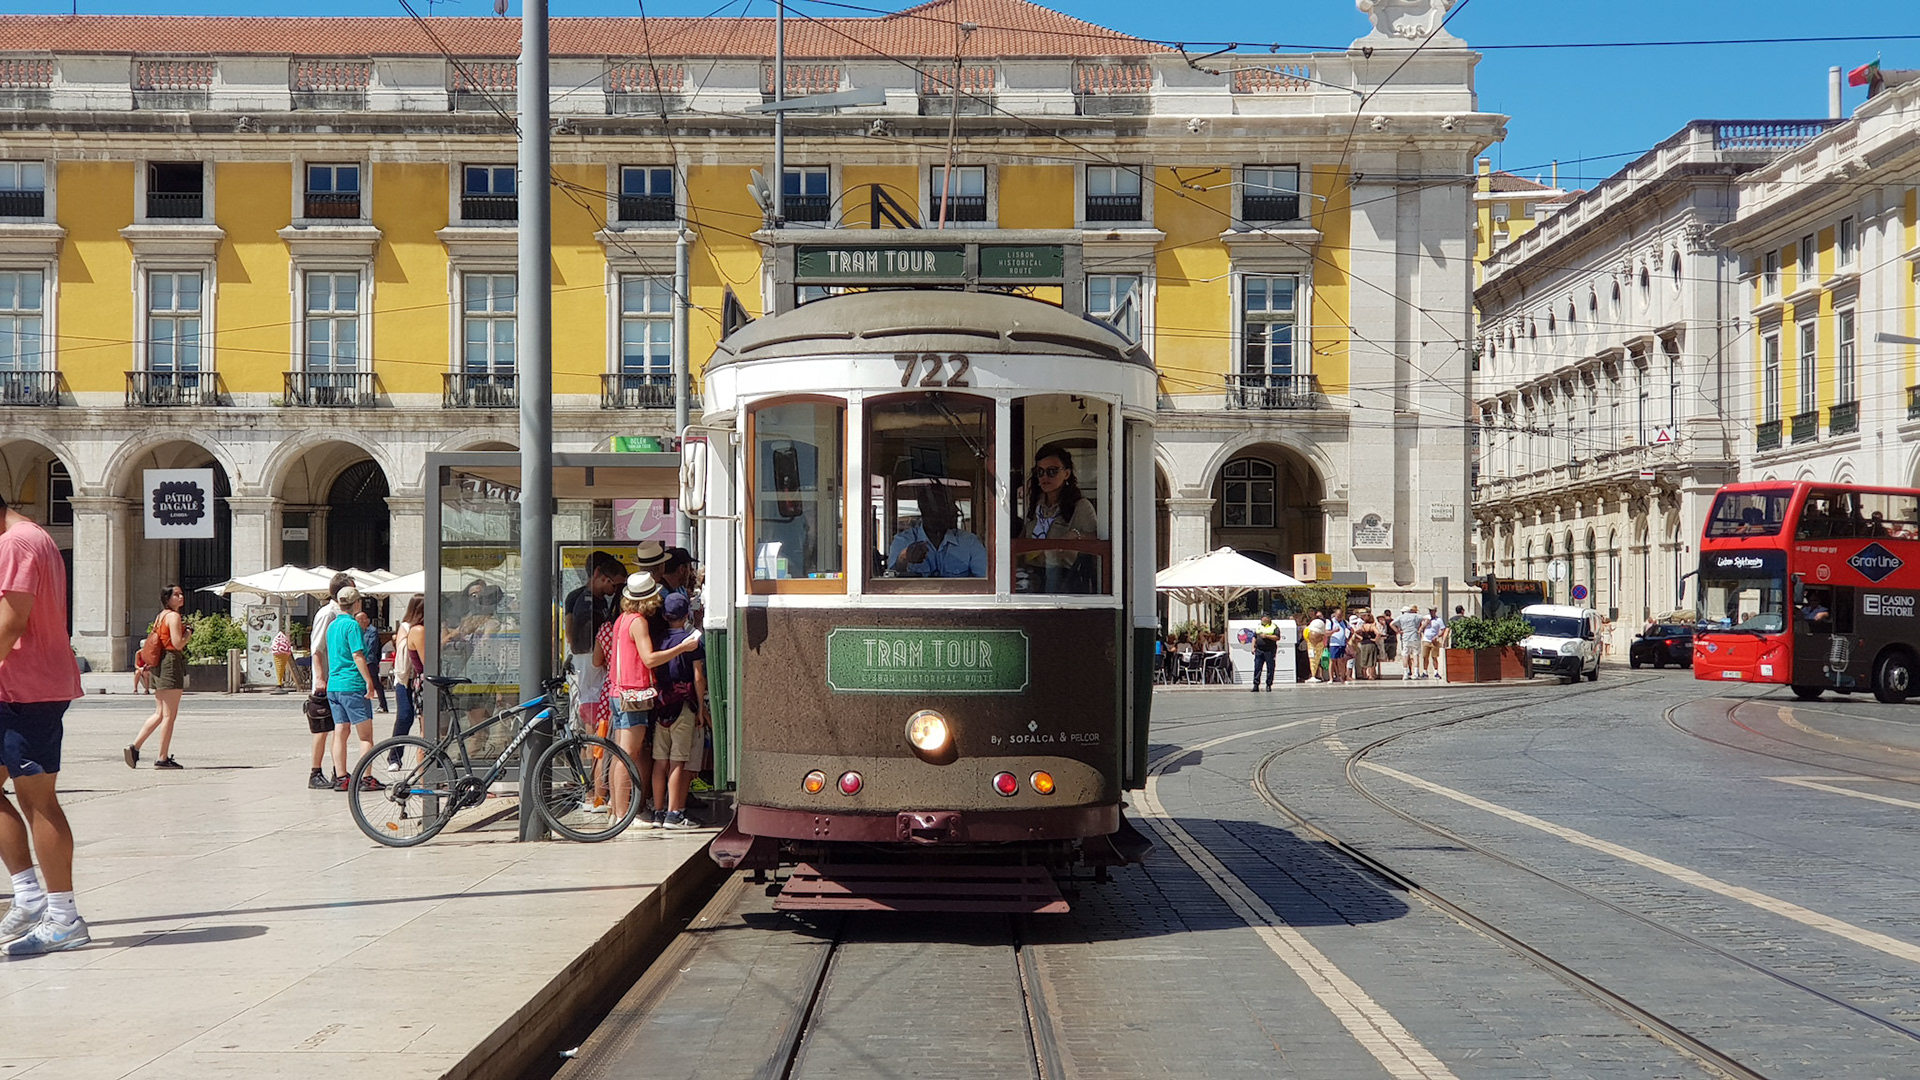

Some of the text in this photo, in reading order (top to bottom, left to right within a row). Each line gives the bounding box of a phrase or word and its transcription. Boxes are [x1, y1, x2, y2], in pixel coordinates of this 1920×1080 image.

[1007, 251, 1034, 259] LISBON
[827, 250, 936, 272] TRAM TOUR
[1009, 267, 1032, 275] ROUTE
[894, 354, 969, 387] 722
[164, 492, 193, 503] PÁTIO
[160, 503, 173, 511] DA
[1882, 595, 1915, 606] CASINO
[1882, 606, 1915, 617] ESTORIL
[863, 639, 993, 668] TRAM TOUR
[902, 674, 956, 683] HISTORICAL
[991, 731, 1100, 745] By SOFALCA & PELCOR
